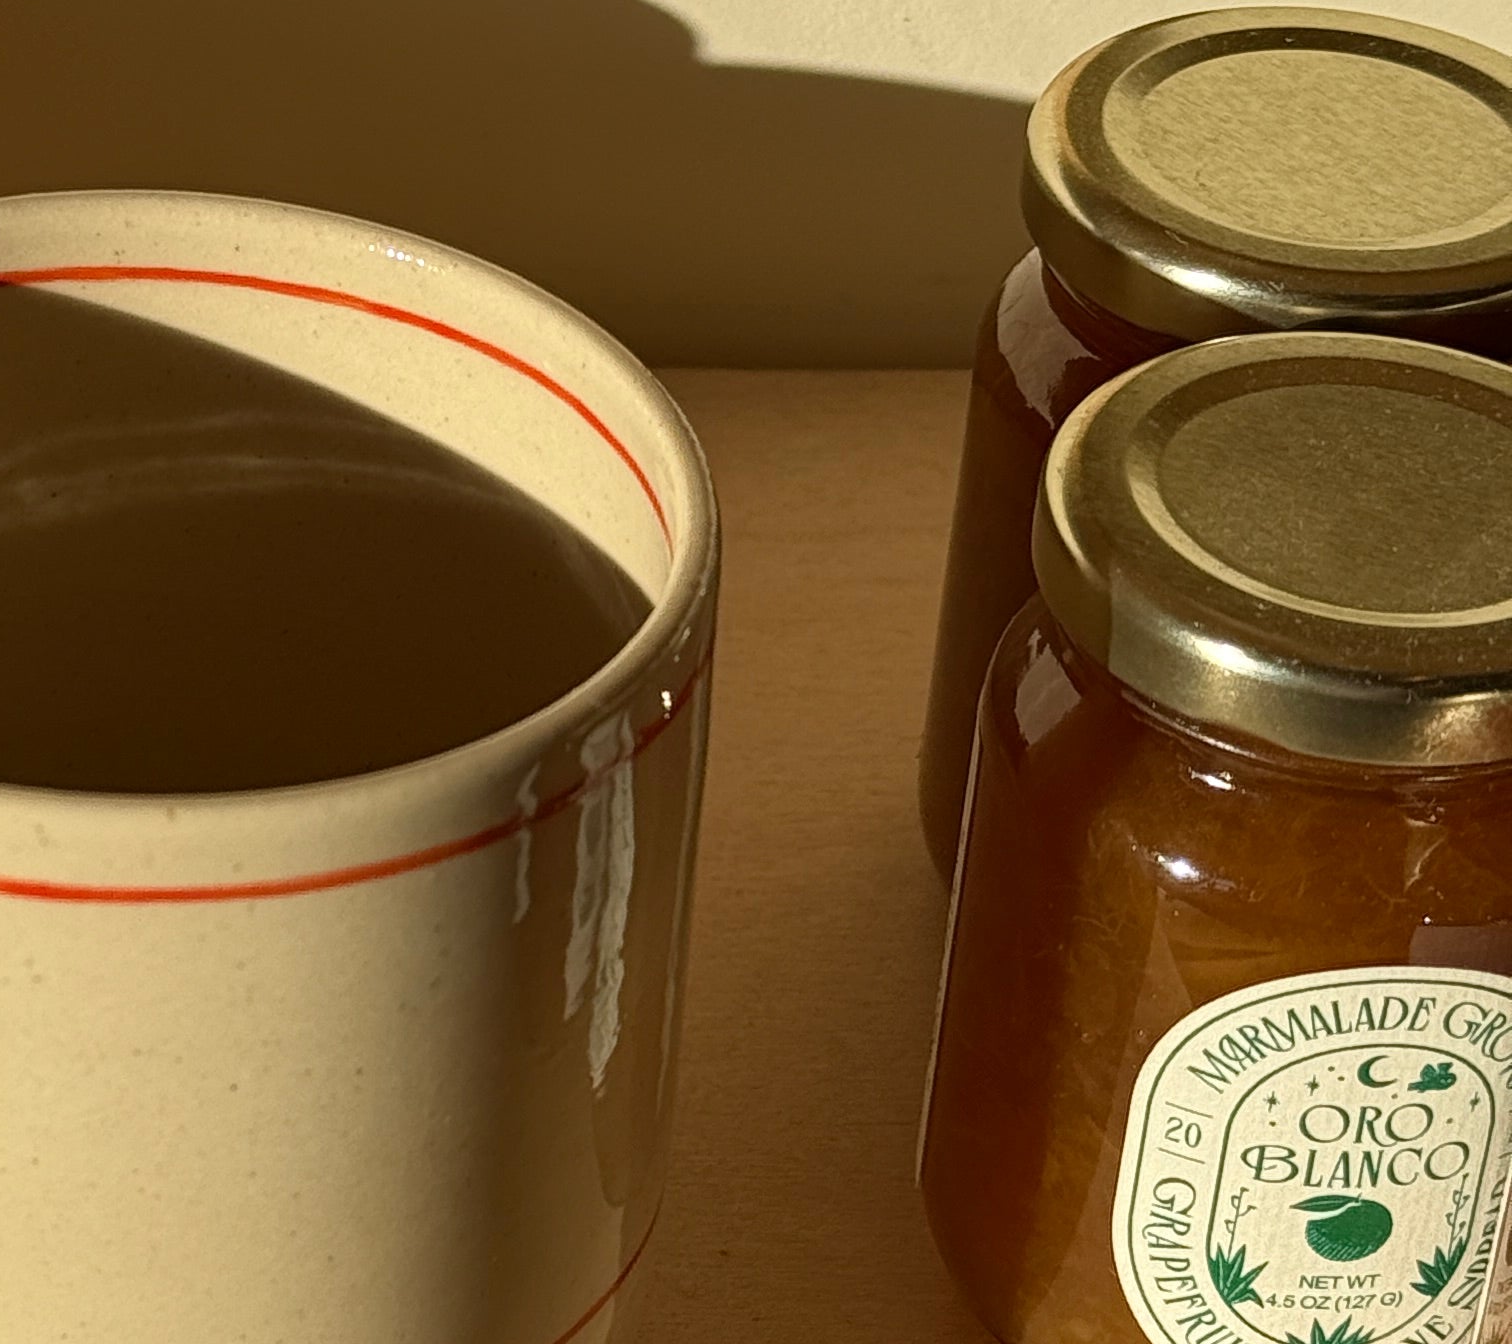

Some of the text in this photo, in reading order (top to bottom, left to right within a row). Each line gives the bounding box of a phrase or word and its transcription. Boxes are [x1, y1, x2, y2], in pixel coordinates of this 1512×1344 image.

[1186, 995, 1437, 1094] MARMALADE
[1164, 1116, 1203, 1149] 20
[1298, 1102, 1434, 1148] ORO
[1240, 1141, 1470, 1189] BLANCO
[1299, 1273, 1382, 1290] NET WT
[1265, 1293, 1296, 1309] 4.5
[1300, 1295, 1332, 1310] OZ
[1335, 1294, 1377, 1313] (127
